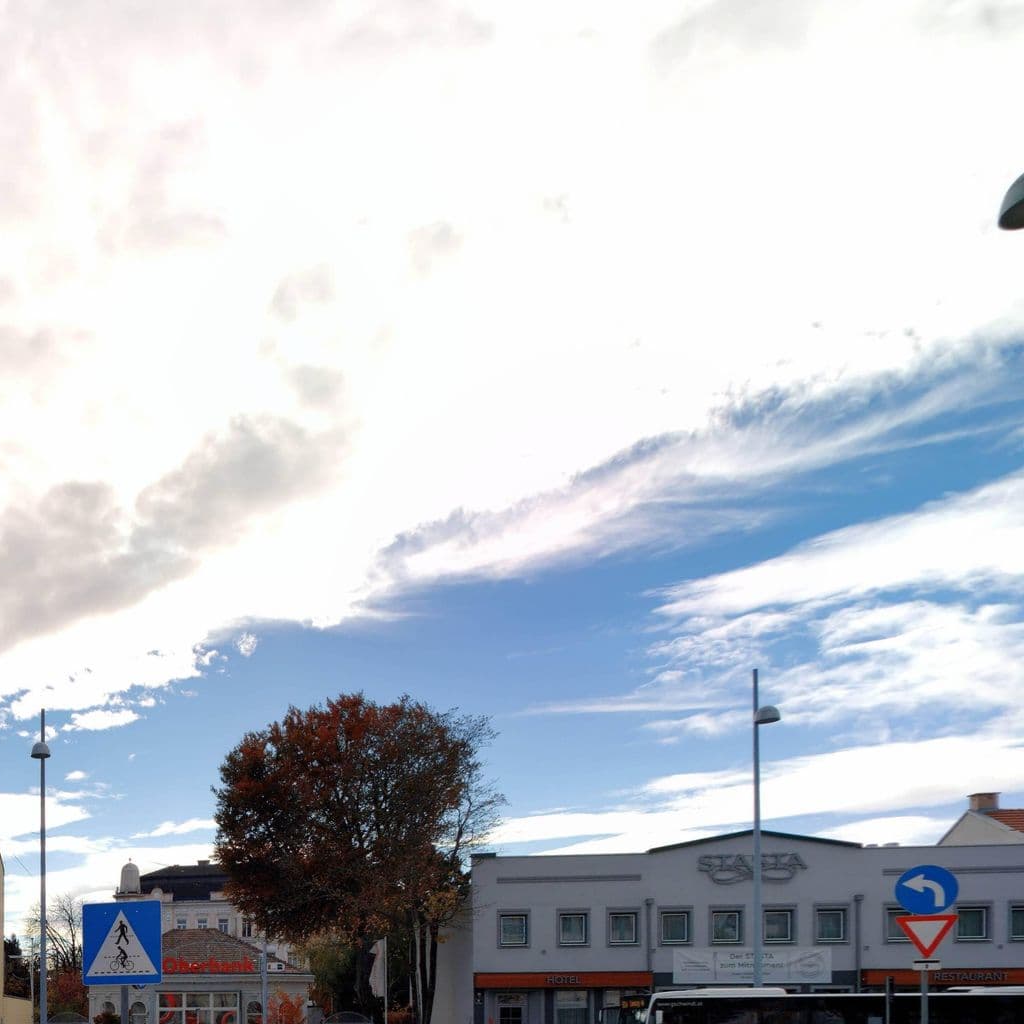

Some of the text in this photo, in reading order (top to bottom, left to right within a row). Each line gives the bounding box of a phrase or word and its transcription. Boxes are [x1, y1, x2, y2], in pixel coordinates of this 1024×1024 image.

[162, 956, 255, 973] Oberbank
[546, 976, 581, 984] HOTEL
[933, 972, 1008, 981] RESTAURANT
